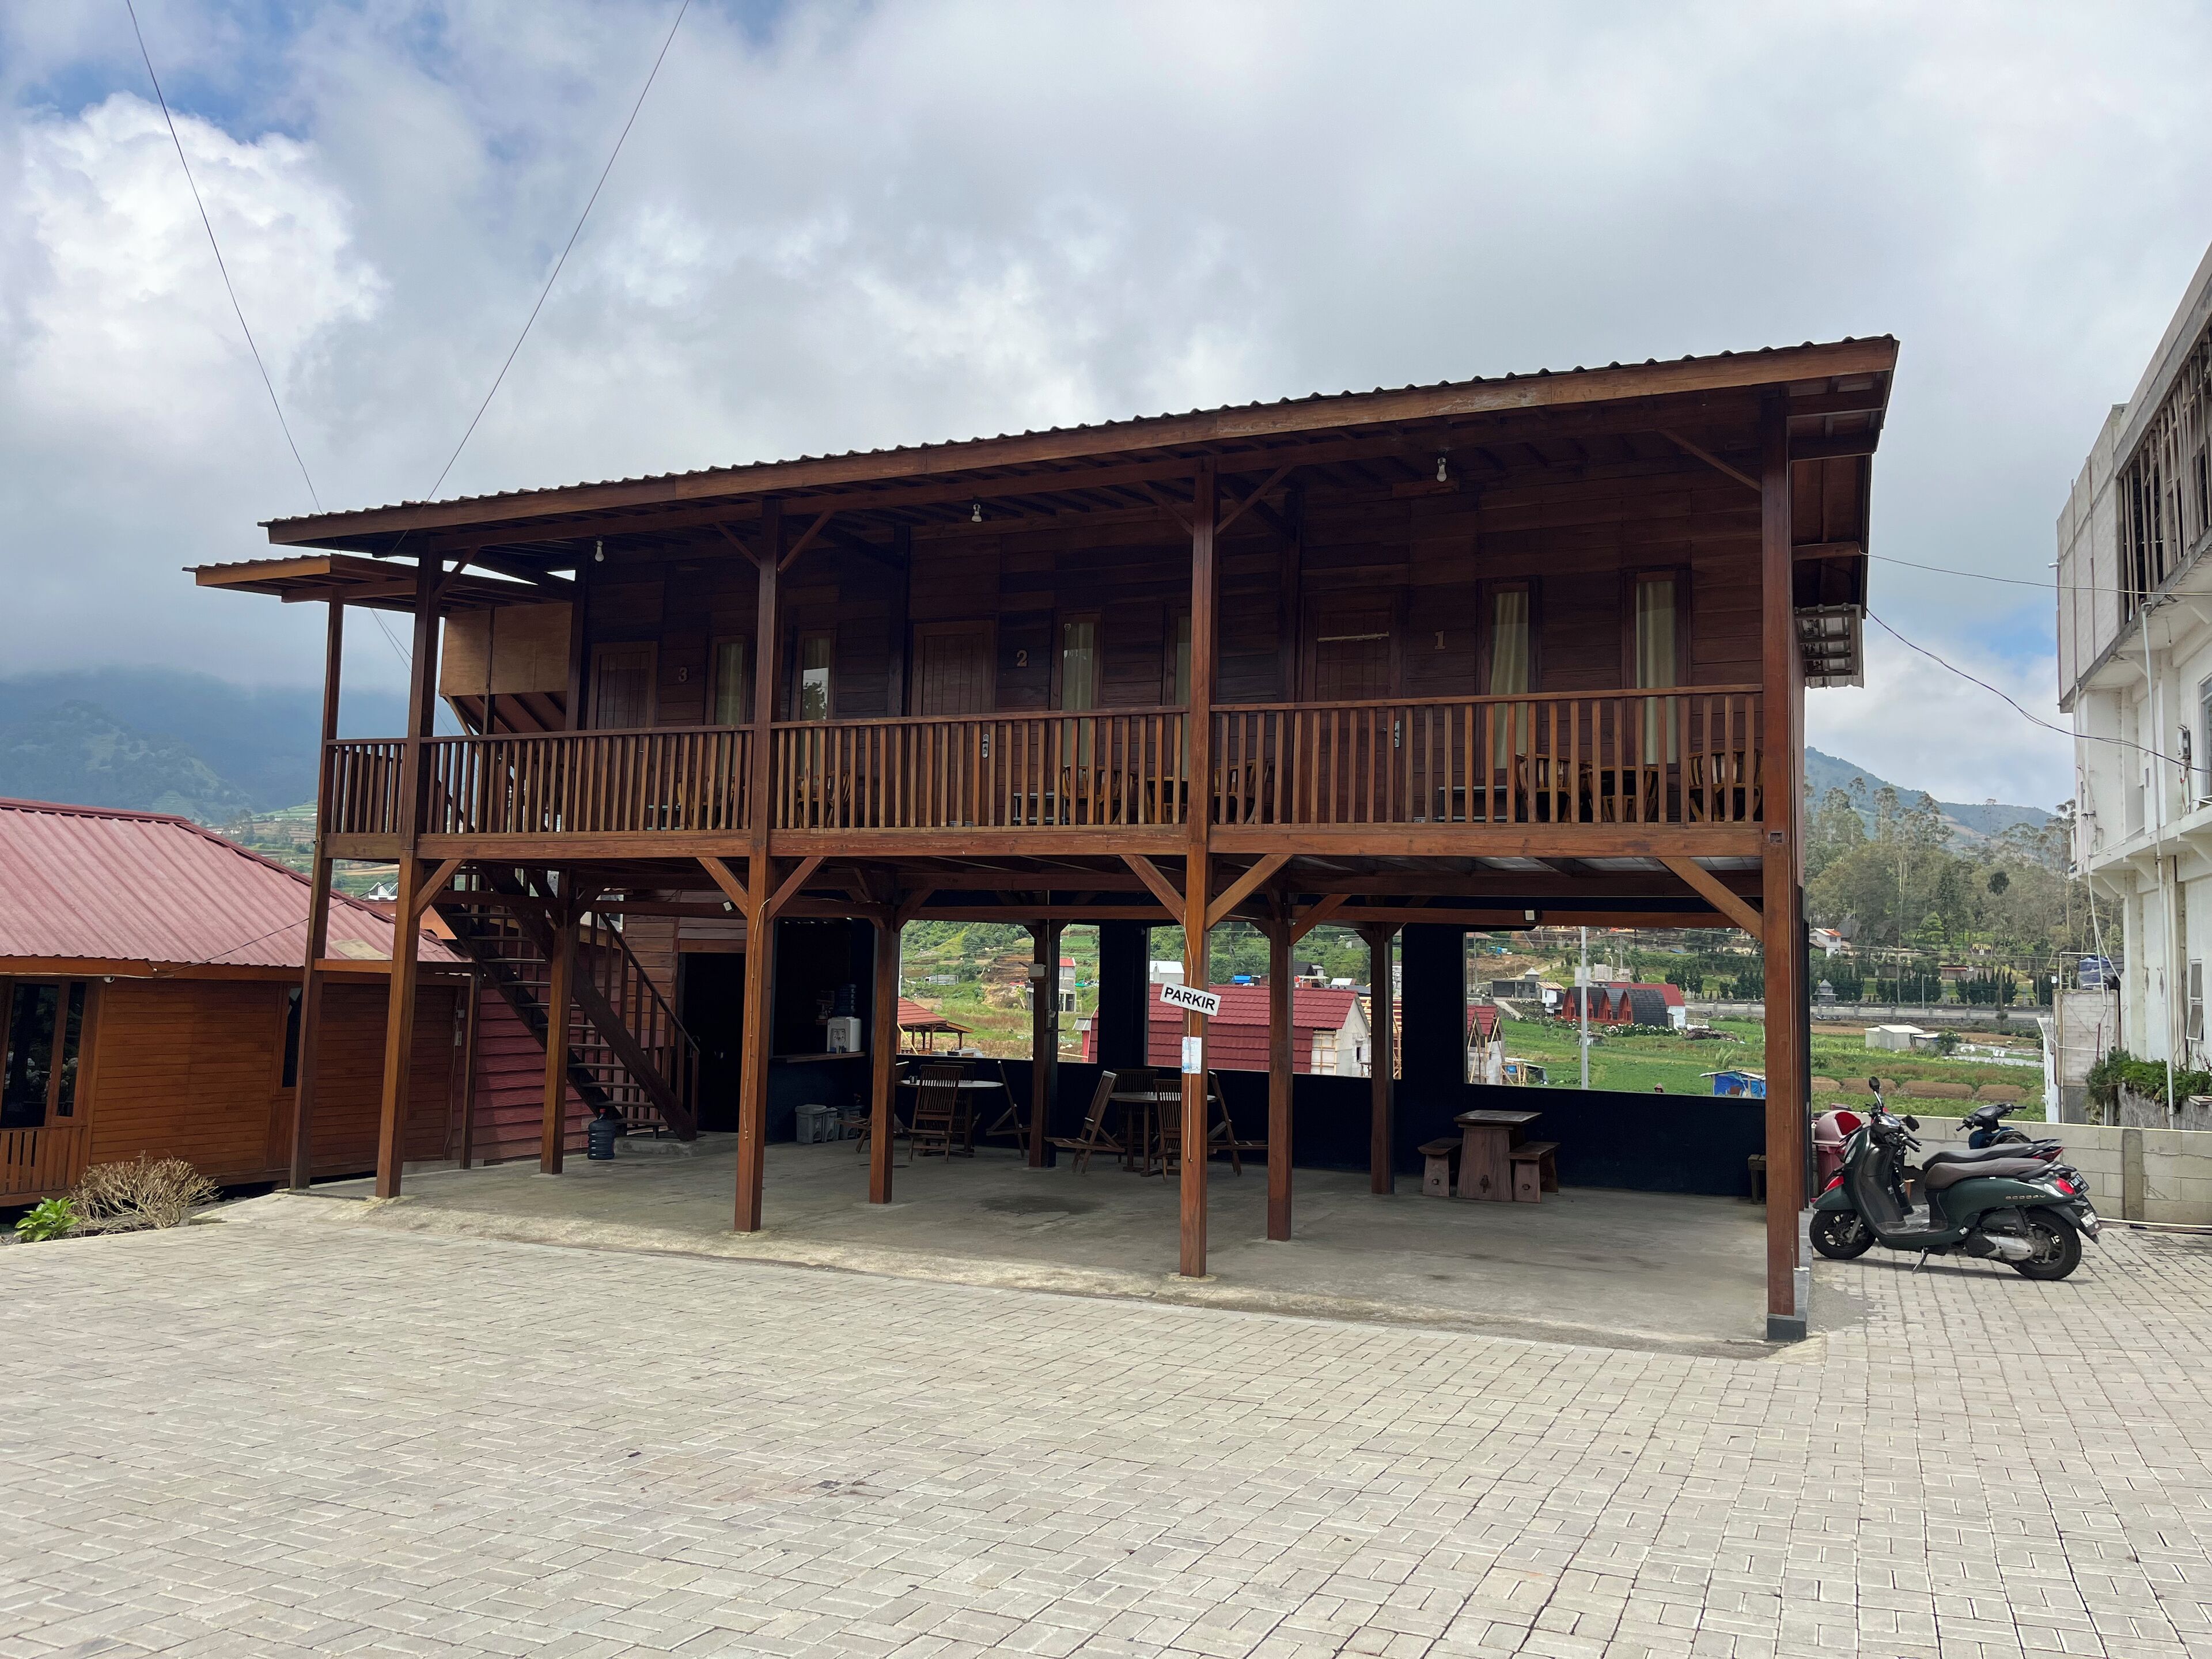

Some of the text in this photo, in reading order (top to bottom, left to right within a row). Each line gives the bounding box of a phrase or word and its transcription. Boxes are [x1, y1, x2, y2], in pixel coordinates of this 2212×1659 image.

[1434, 630, 1445, 650] 1
[1017, 650, 1028, 667] 2
[678, 666, 688, 682] 3
[1164, 987, 1215, 1010] PARKIR
